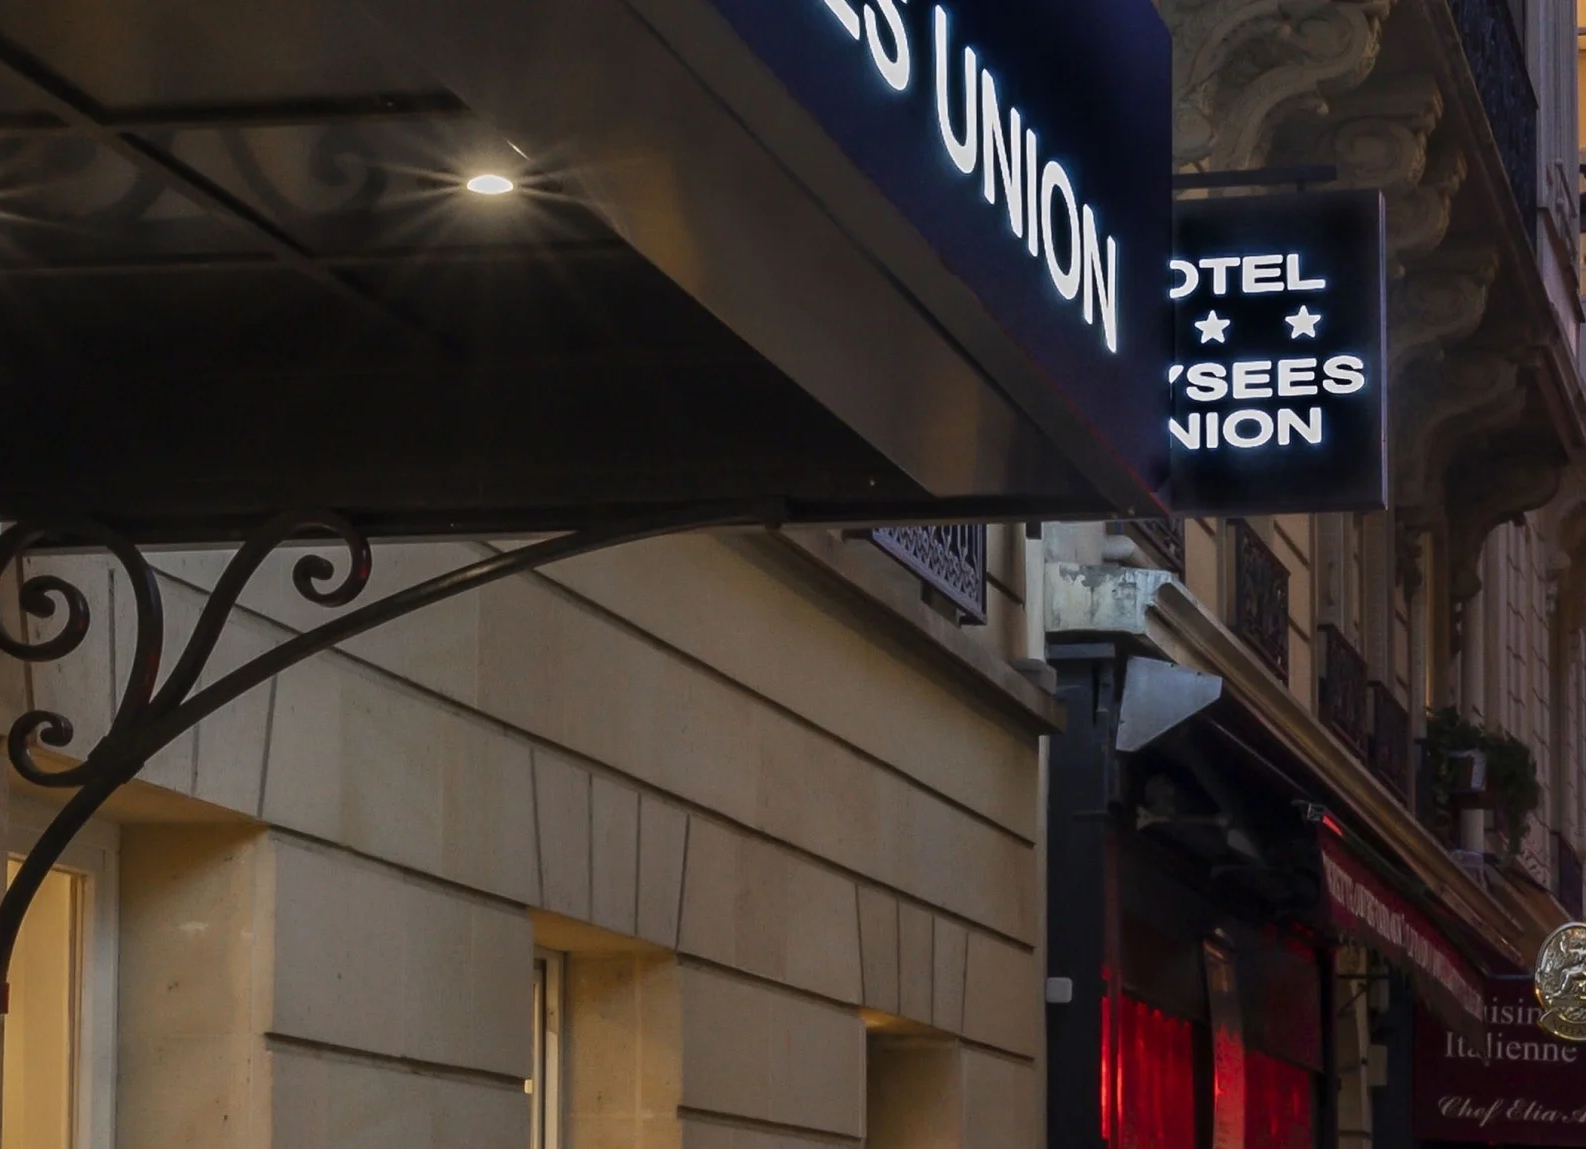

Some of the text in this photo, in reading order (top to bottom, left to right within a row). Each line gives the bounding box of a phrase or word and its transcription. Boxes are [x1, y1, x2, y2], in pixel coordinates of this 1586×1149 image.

[822, 0, 1117, 354] S UNION
[1169, 253, 1326, 299] OTEL
[1169, 355, 1365, 401] SEES
[1169, 407, 1322, 450] NION
[1483, 996, 1544, 1025] isin
[1438, 1095, 1504, 1128] Chef
